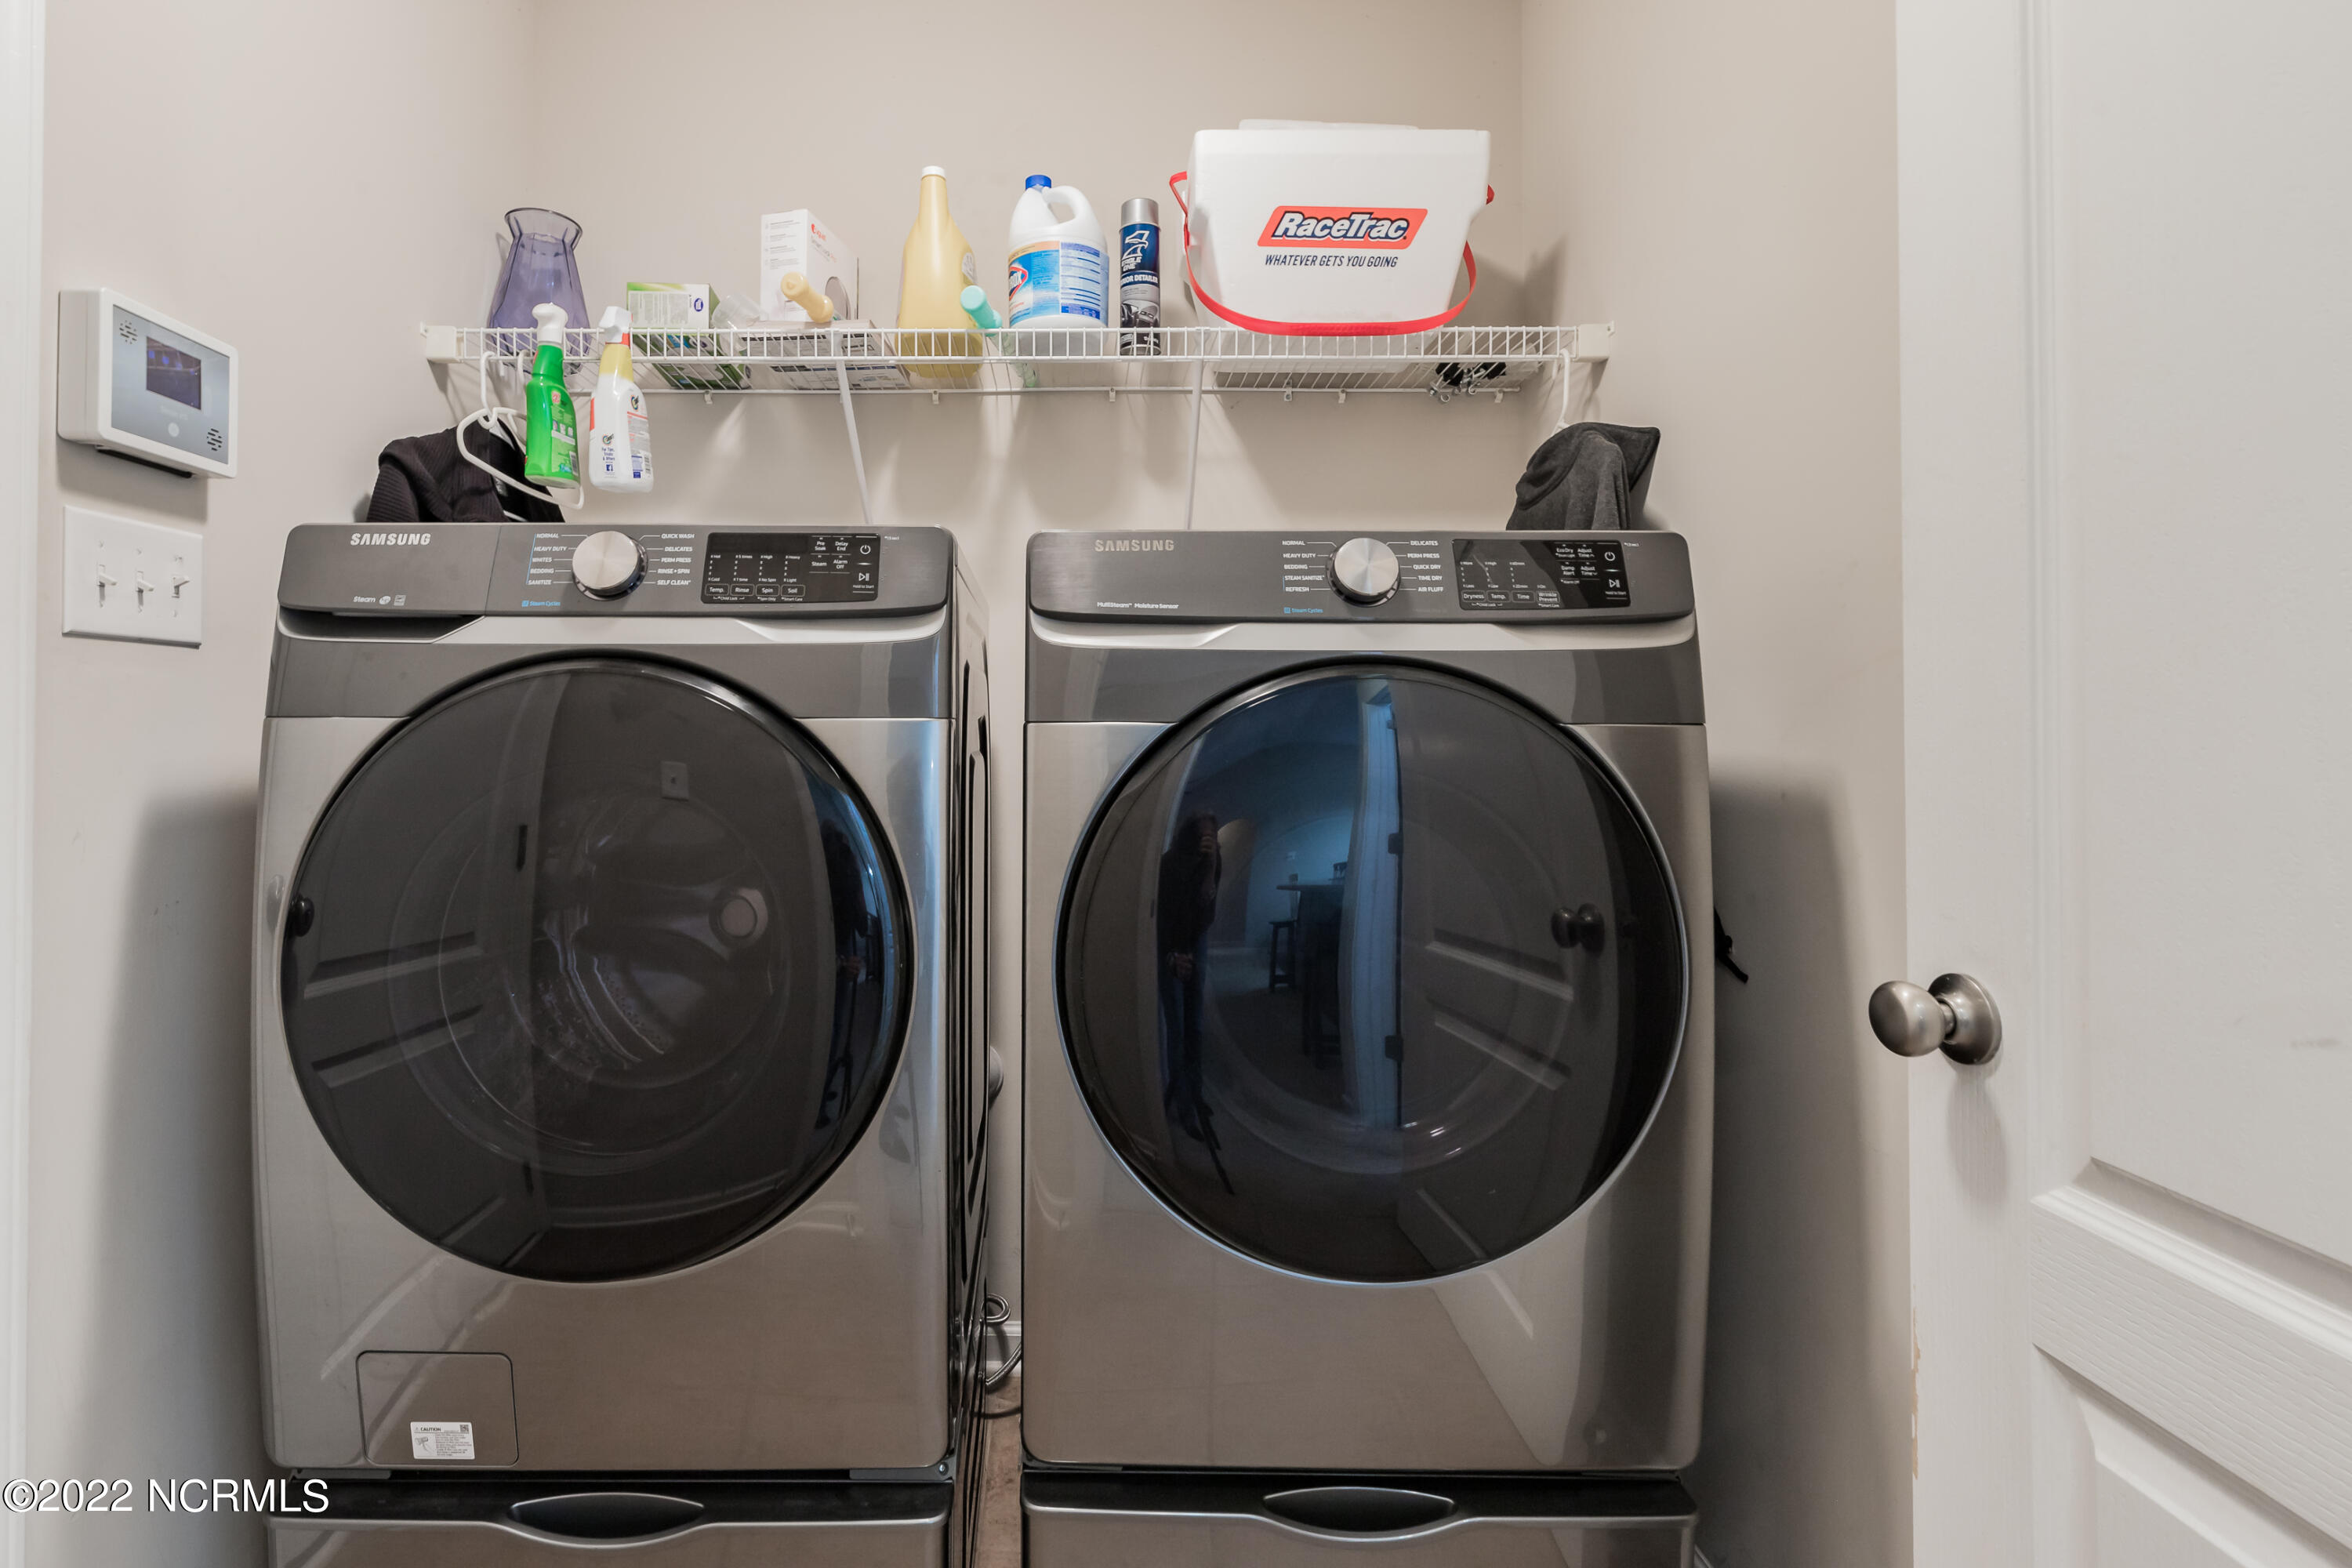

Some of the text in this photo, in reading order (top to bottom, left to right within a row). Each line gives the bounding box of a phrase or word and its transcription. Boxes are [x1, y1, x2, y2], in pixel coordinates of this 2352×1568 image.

[1272, 210, 1410, 241] RaceTrac
[1265, 254, 1399, 267] WHATEVER GETS YOU GOING
[350, 533, 431, 545] SAMSUNG
[1094, 539, 1174, 551] SAMSUNG
